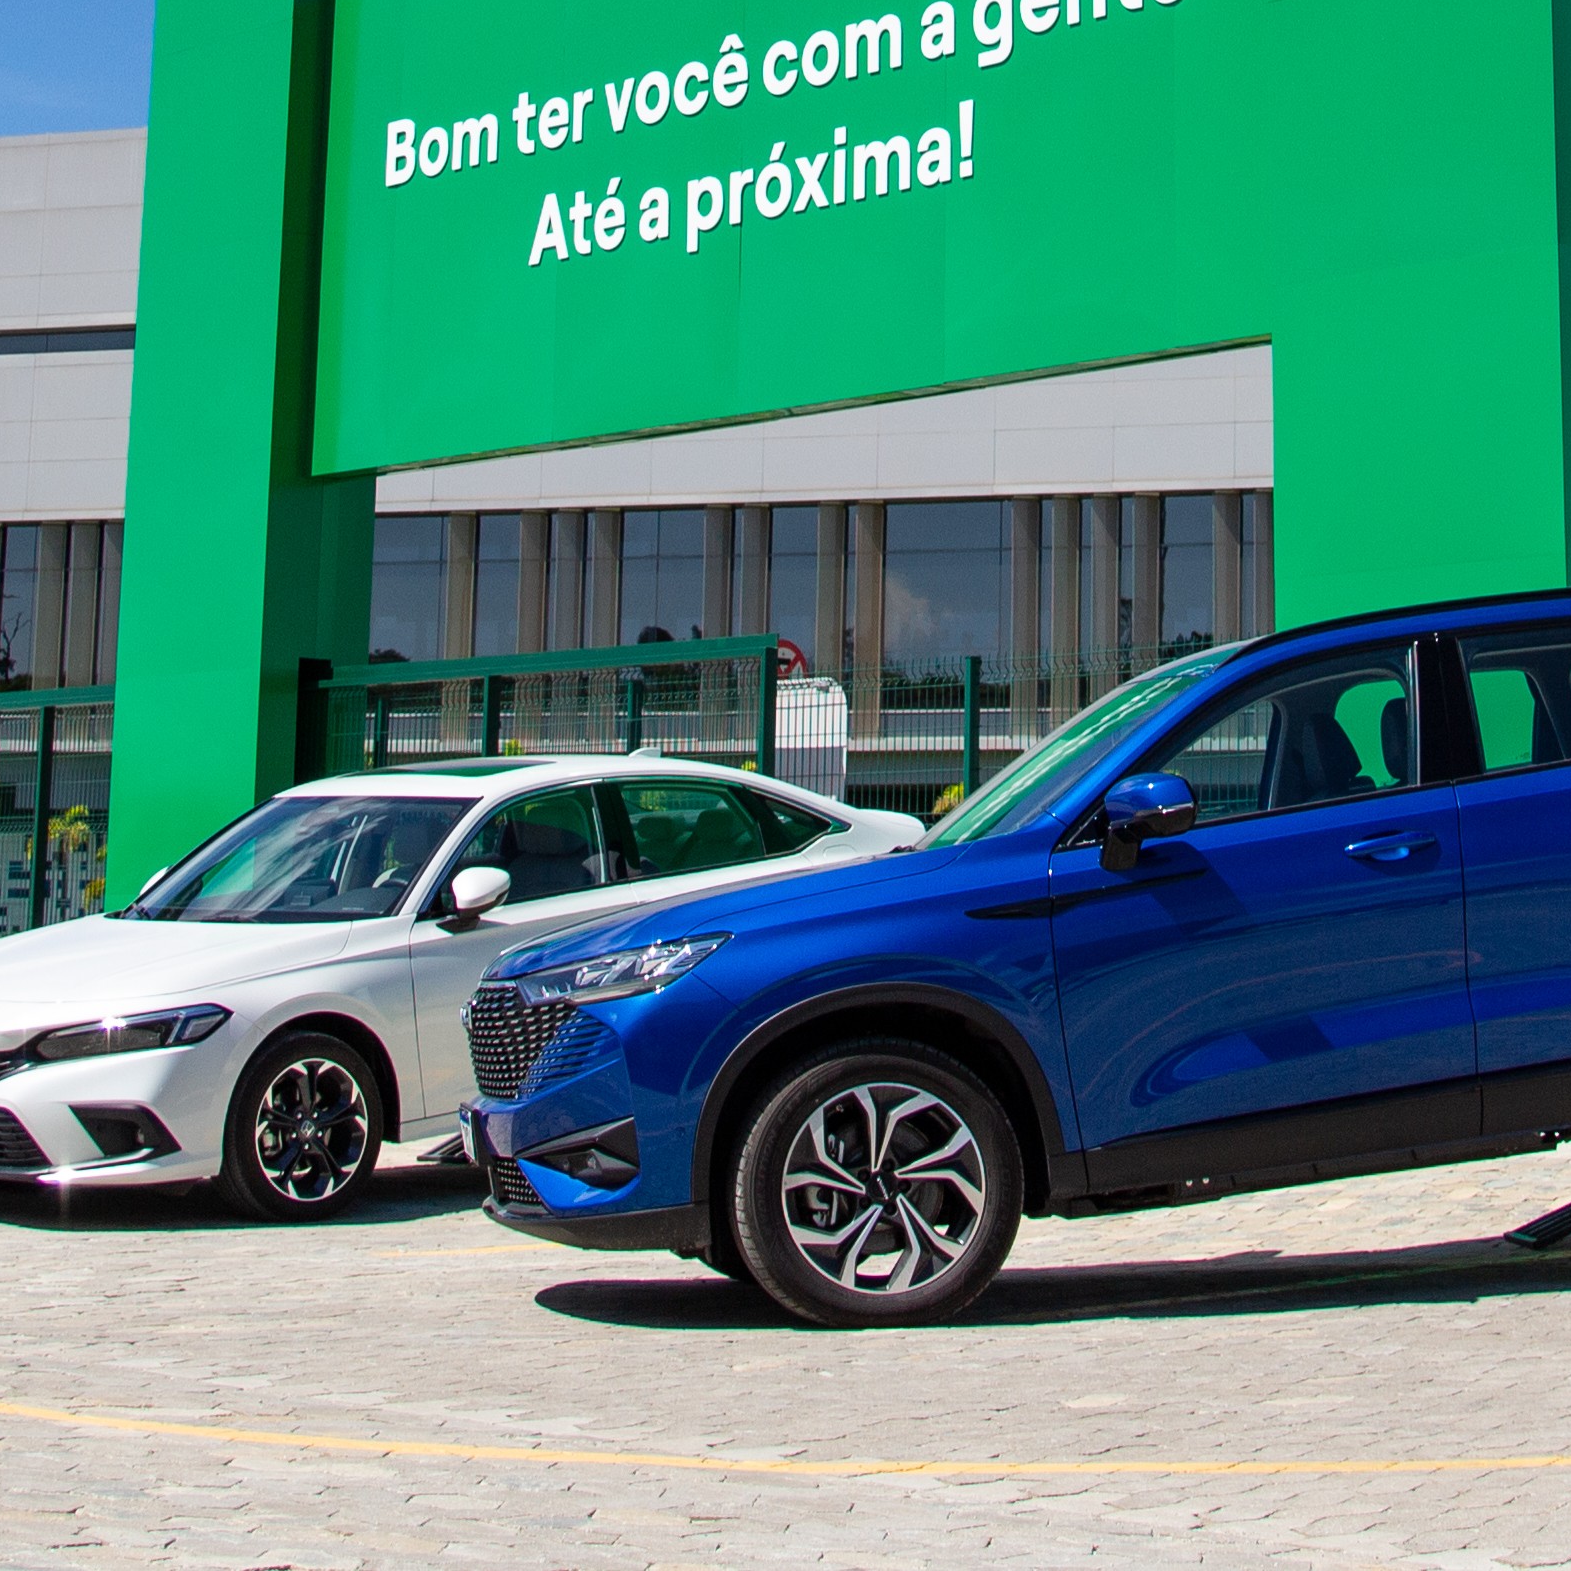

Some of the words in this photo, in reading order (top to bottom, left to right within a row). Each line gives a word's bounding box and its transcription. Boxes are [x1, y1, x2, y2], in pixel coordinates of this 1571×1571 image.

[385, 119, 499, 187] Bom
[512, 89, 593, 154] ter
[604, 34, 749, 132] você
[762, 13, 902, 95] com
[920, 1, 955, 59] a
[528, 177, 625, 266] Até
[639, 187, 669, 243] a
[686, 99, 974, 253] próxima!
